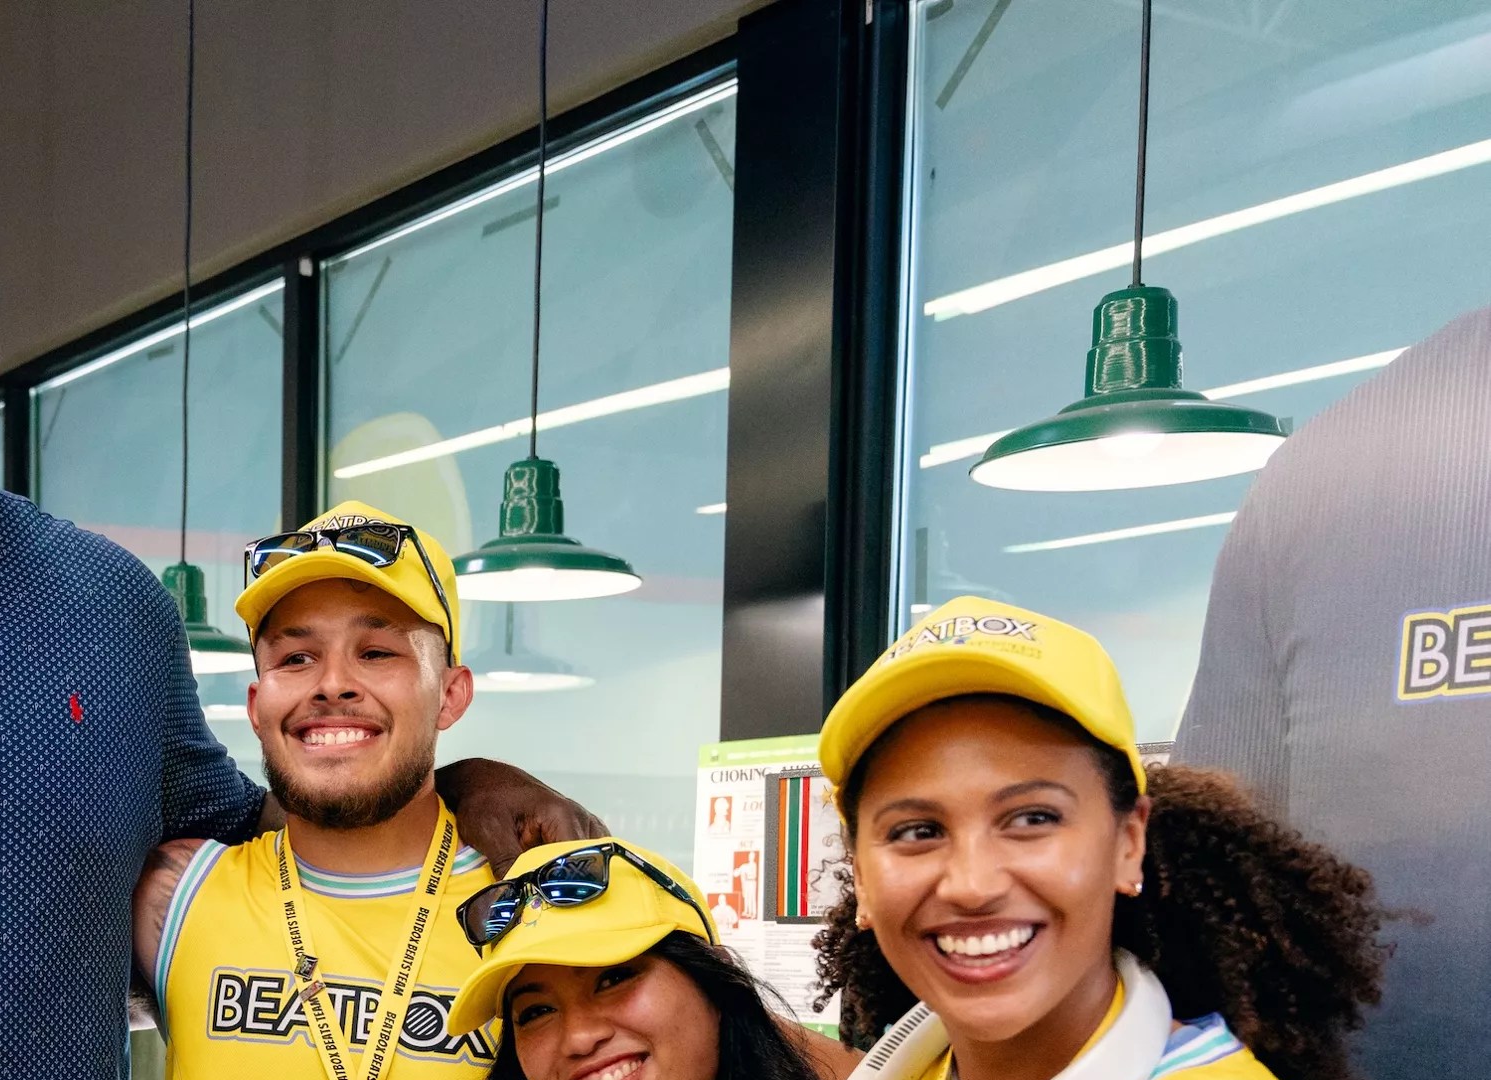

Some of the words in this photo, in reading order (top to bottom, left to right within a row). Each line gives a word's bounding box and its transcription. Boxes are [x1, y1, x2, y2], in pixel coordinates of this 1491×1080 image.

[425, 874, 440, 896] TEAM
[284, 900, 296, 919] TEAM
[288, 920, 302, 946] BEATS
[410, 907, 429, 945] BEATBOX
[401, 943, 419, 971] BEATS
[393, 970, 410, 997] TEAM
[317, 1021, 337, 1050] BEATS
[376, 1011, 397, 1053] BEATBOX
